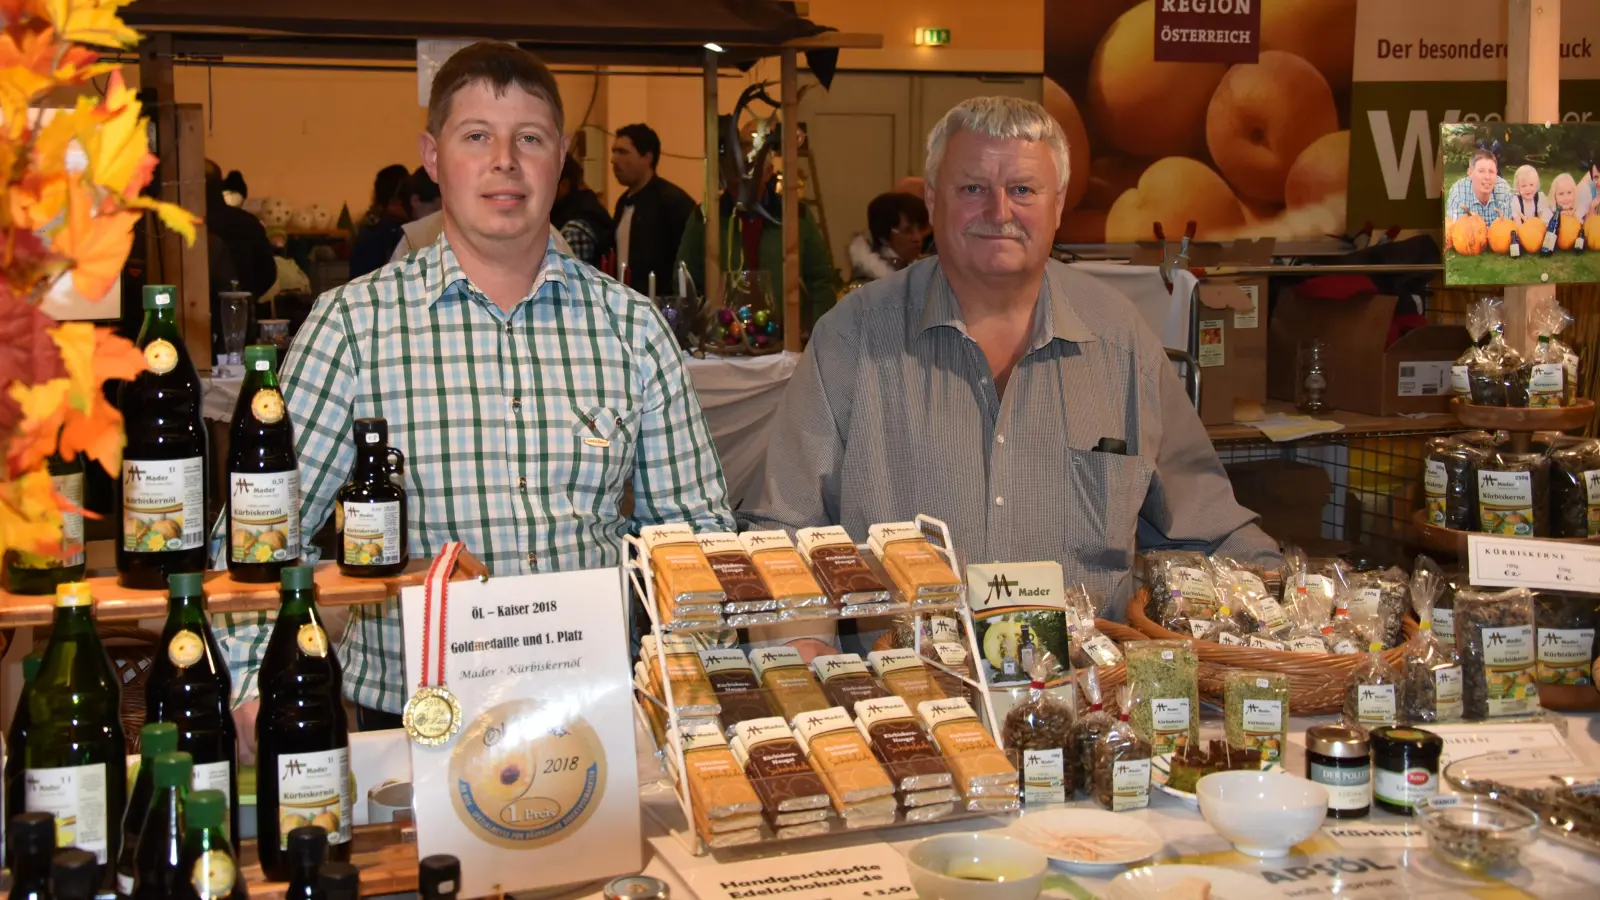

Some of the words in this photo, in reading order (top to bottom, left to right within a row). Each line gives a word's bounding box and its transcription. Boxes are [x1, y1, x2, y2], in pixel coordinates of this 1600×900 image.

[1161, 0, 1251, 14] REGION
[1161, 25, 1251, 43] ÖSTERREICH
[1377, 38, 1413, 58] Der
[1483, 492, 1526, 501] Kürbiskerne
[234, 508, 282, 516] Kürbiskernöl
[1485, 548, 1566, 560] KÜRBISKERNE
[1018, 588, 1050, 597] Mader
[472, 606, 485, 619] ÖL
[497, 603, 530, 617] Kaiser
[532, 601, 557, 614] 2018
[451, 636, 520, 654] Goldmedaille
[523, 633, 543, 646] und
[545, 633, 554, 643] 1.
[557, 630, 583, 643] Platz
[459, 667, 496, 680] Mader
[507, 657, 581, 676] Kürbiskernöl
[543, 756, 580, 774] 2018
[1322, 770, 1341, 779] DER
[524, 808, 556, 821] Preis
[720, 864, 881, 890] Handgeschöpfte
[729, 873, 884, 900] Edelschokolade
[875, 885, 912, 898] 3,50
